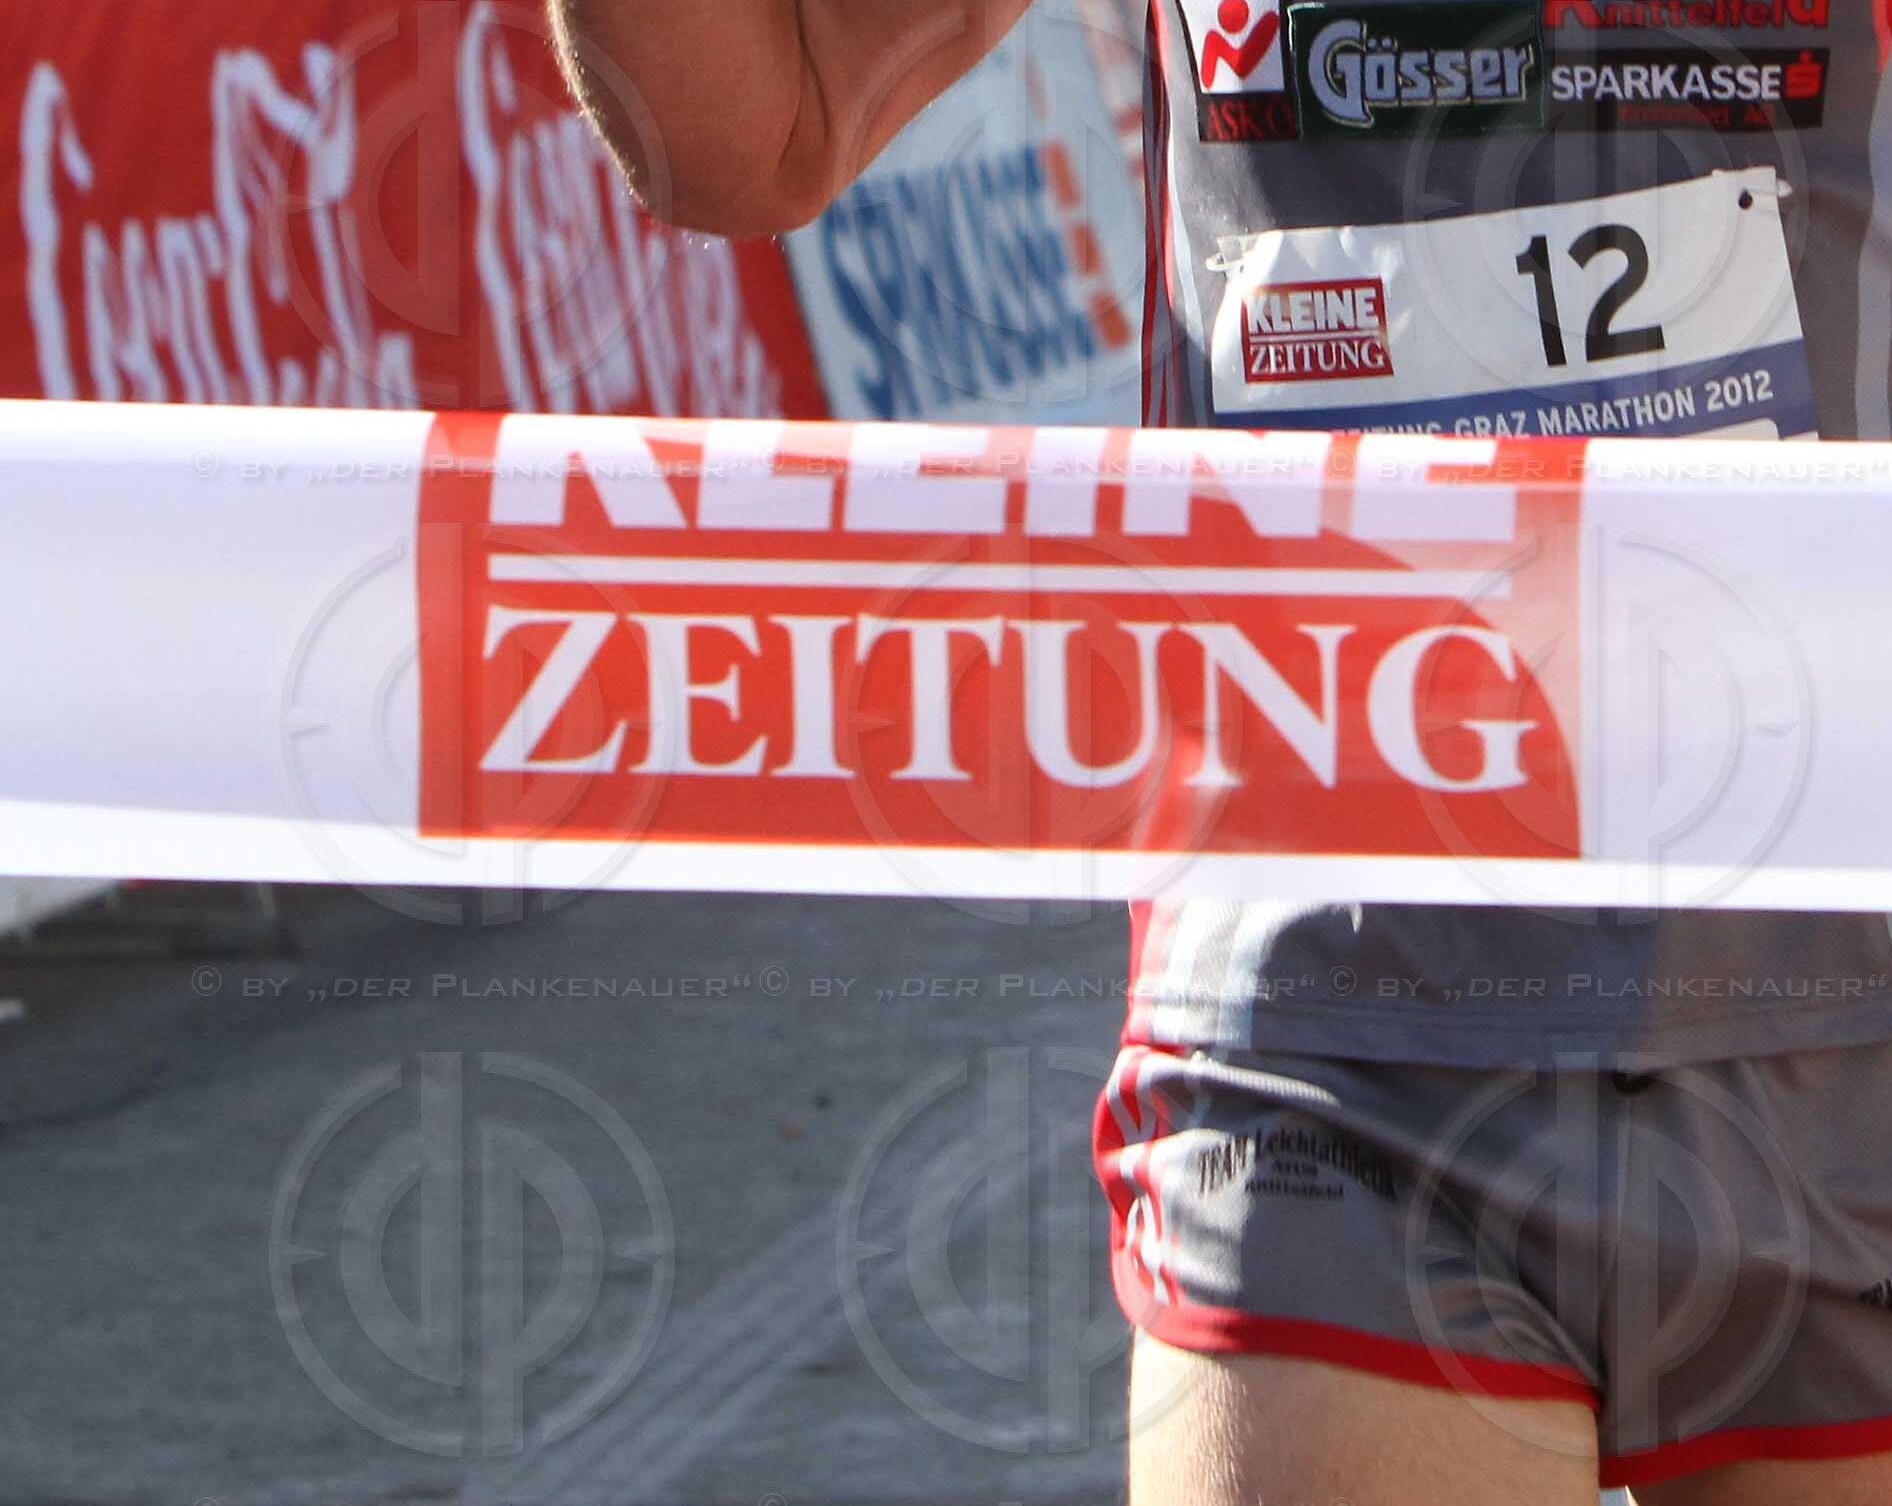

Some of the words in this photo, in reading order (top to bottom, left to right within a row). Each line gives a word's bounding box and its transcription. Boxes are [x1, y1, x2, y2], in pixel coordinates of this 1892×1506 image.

[1307, 18, 1534, 129] Gösser
[1551, 64, 1782, 101] SPARKASSE
[1249, 287, 1379, 334] KLEINE
[1516, 223, 1667, 369] 12
[1250, 339, 1386, 375] ZEITUNG
[1537, 385, 1696, 437] MARATHON
[1706, 368, 1775, 413] 2012
[477, 603, 1539, 796] ZEITUNG
